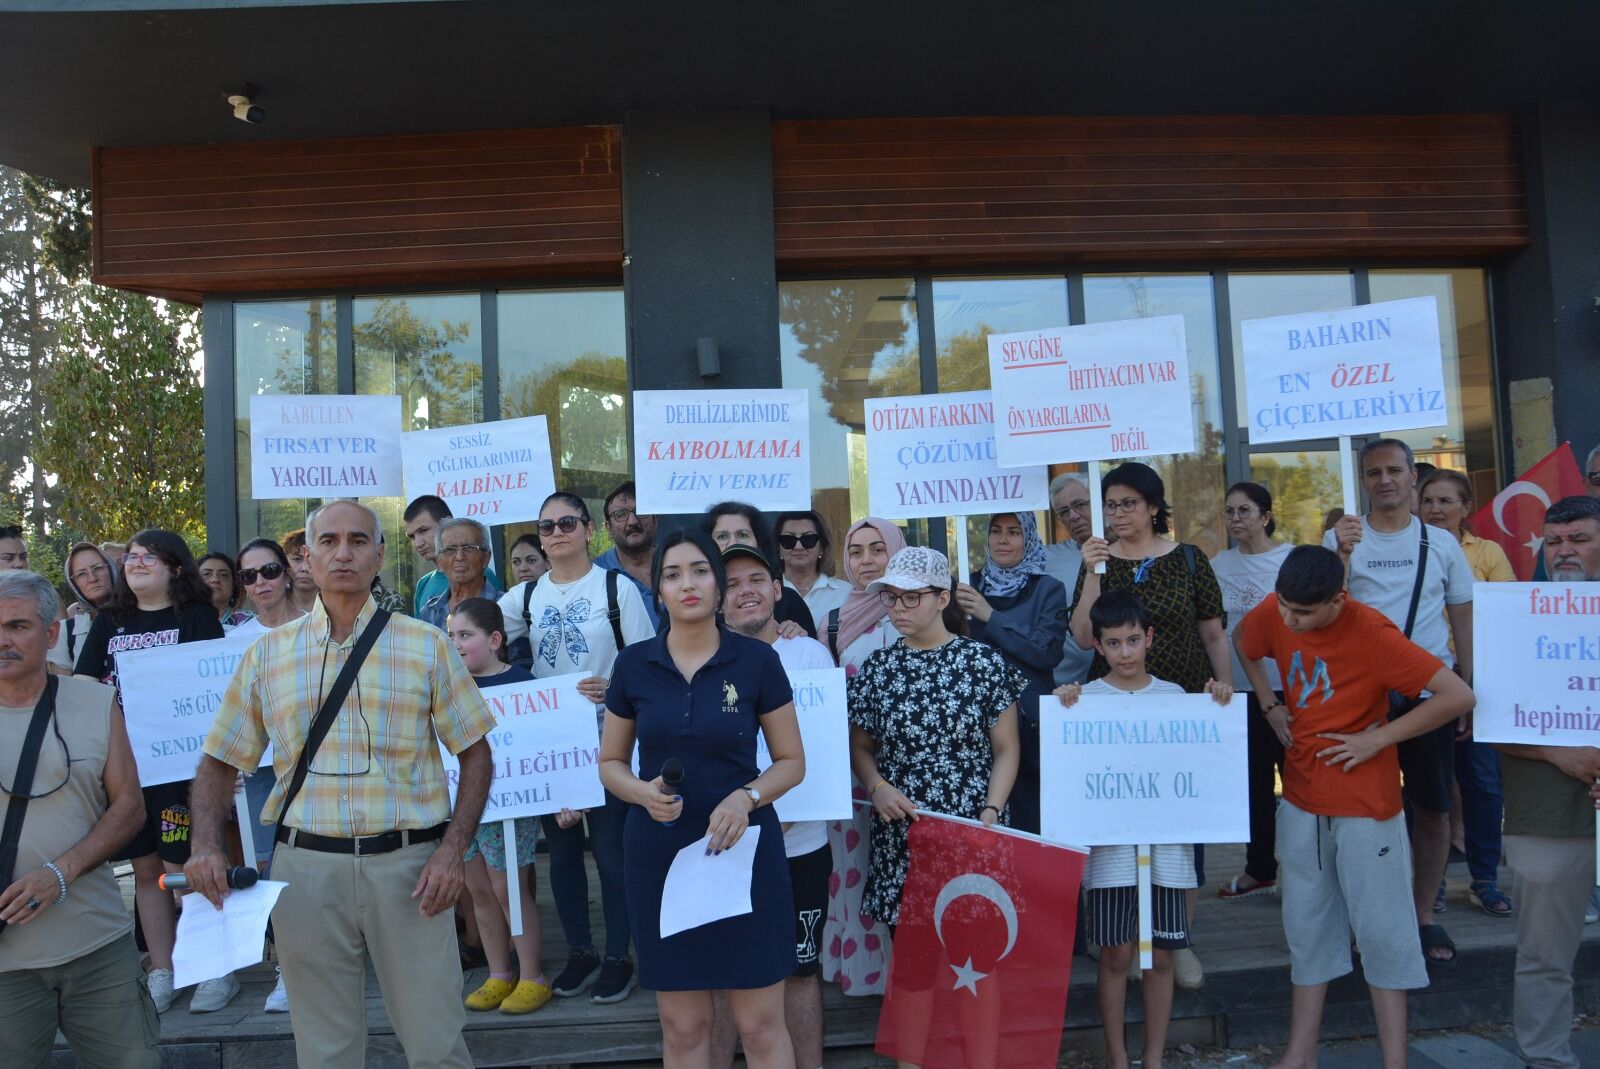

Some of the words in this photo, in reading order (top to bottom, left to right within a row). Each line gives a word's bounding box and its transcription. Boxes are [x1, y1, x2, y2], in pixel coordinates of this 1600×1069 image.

[1287, 317, 1392, 351] BAHARIN
[1002, 334, 1063, 363] SEVGİNE
[1067, 361, 1144, 391] İHTİYACIM
[1147, 361, 1177, 383] VAR
[1278, 372, 1311, 394] EN
[1330, 361, 1395, 389] ÖZEL
[280, 405, 354, 424] KABULLEN
[664, 399, 790, 425] DEHLİZLERİMDE
[872, 403, 926, 432] OTİZM
[1008, 405, 1027, 430] ÖN
[1027, 402, 1111, 428] YARGILARINA
[1256, 387, 1445, 433] ÇİÇEKLERİYİZ
[264, 437, 331, 454] FIRSAT
[336, 437, 376, 453] VER
[449, 432, 492, 450] SESSİZ
[647, 439, 801, 460] KAYBOLMAMA
[1110, 426, 1149, 454] DEĞİL
[270, 465, 377, 487] YARGILAMA
[427, 448, 532, 477] ÇIĞLIKLARIMIZI
[434, 472, 528, 499] KALBİNLE
[667, 471, 709, 491] İZİN
[719, 473, 790, 490] VERME
[895, 475, 1024, 506] YANINDAYIZ
[466, 499, 502, 516] DUY
[1367, 559, 1413, 568] CONVERSION
[107, 628, 180, 655] KUROMI
[172, 696, 193, 718] 365
[510, 688, 560, 716] TANI
[491, 731, 513, 747] ve
[1062, 720, 1221, 745] FIRTINALARIMA
[520, 746, 600, 776] EĞİTİM
[1085, 765, 1161, 800] SIĞINAK
[1174, 771, 1200, 799] OL
